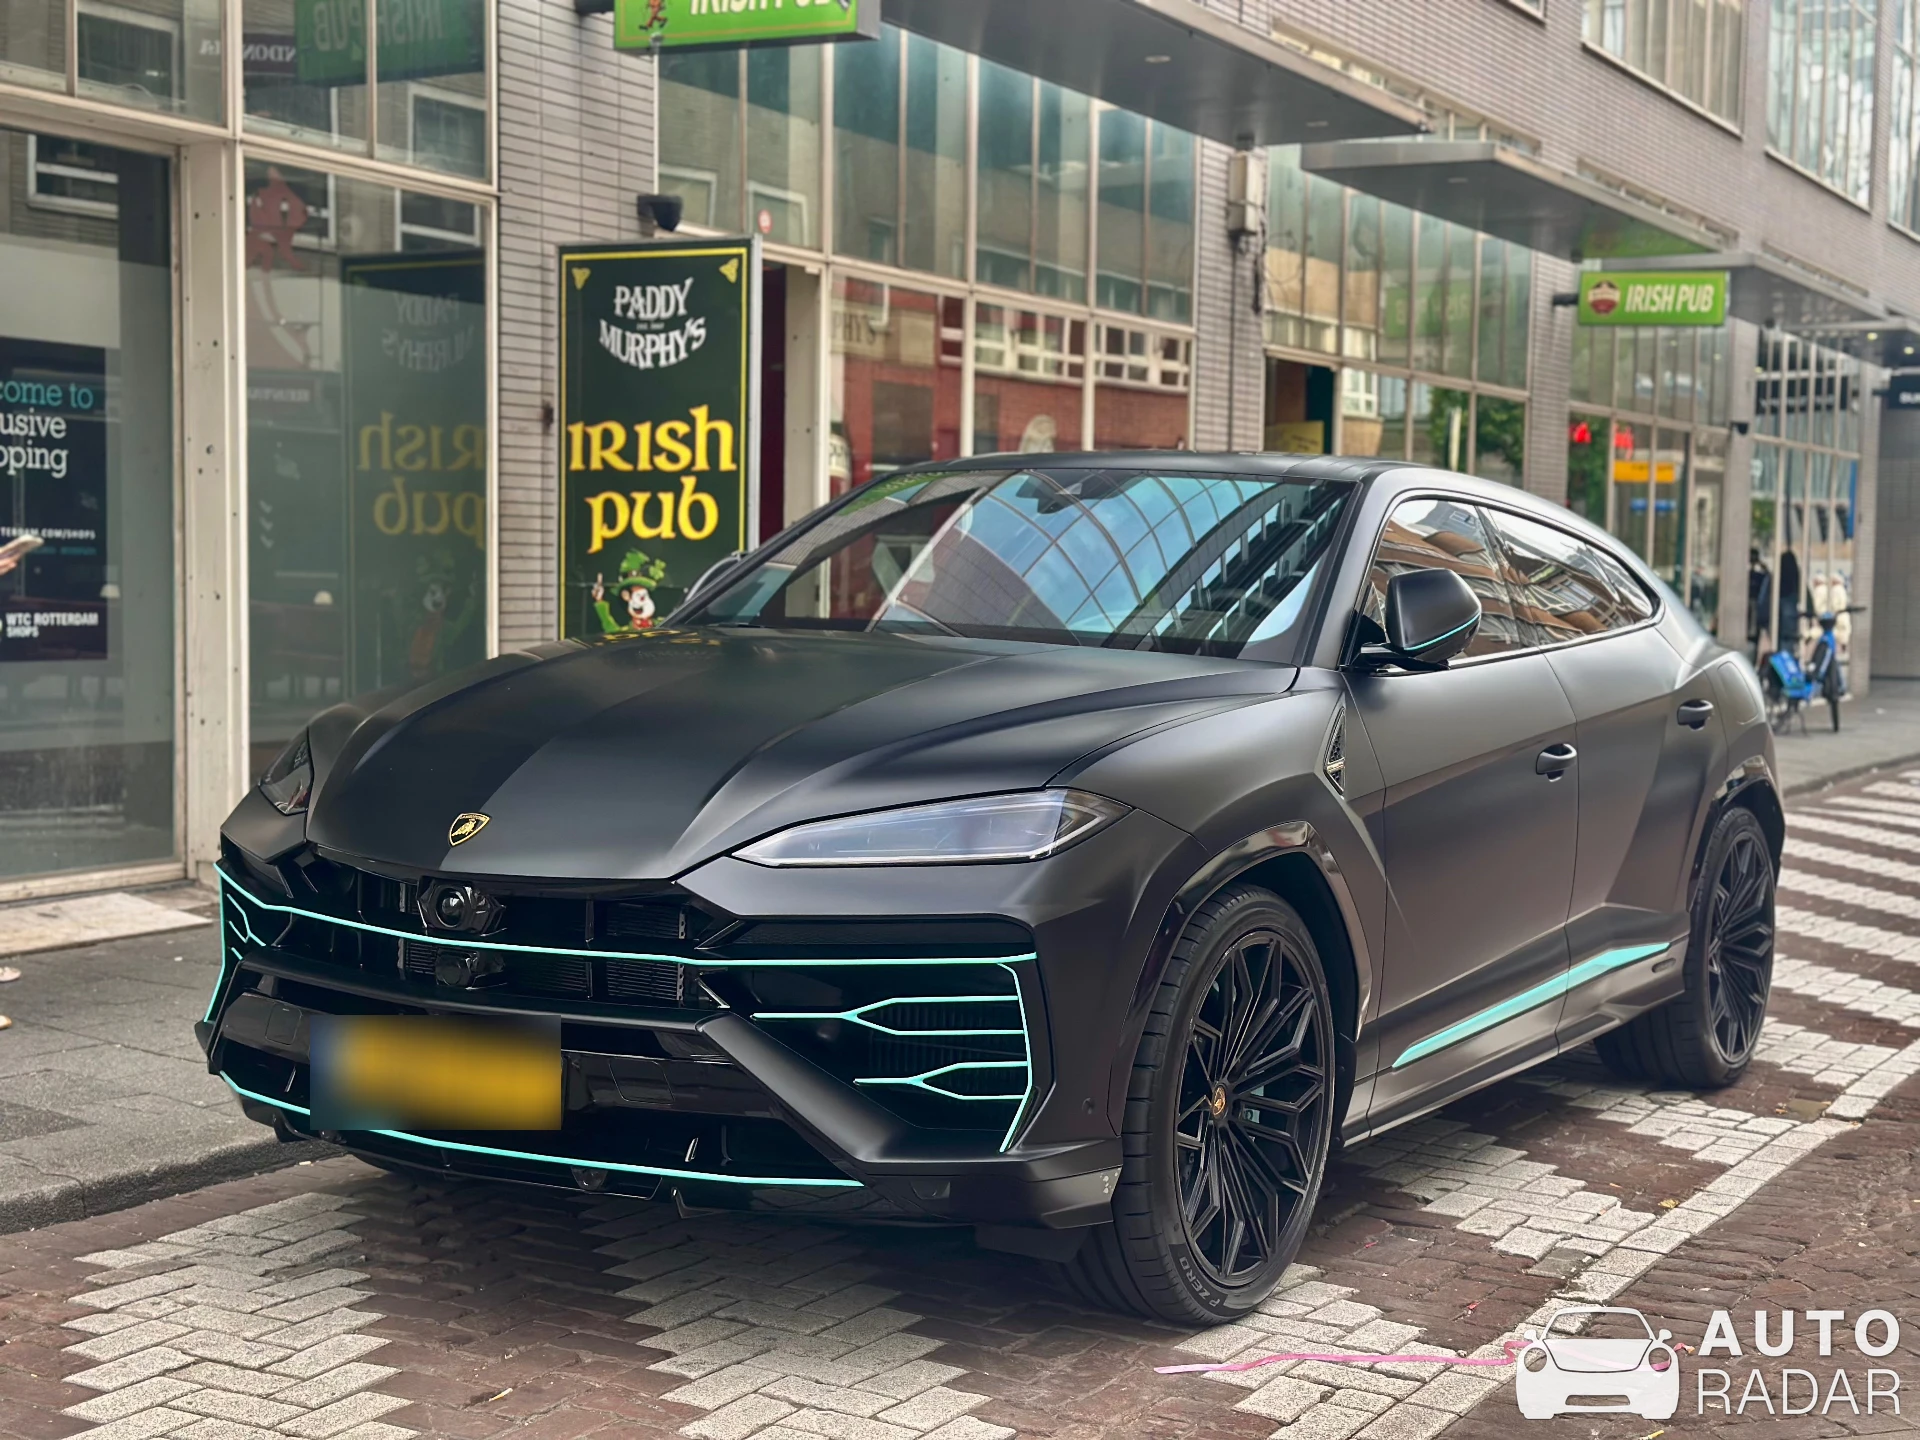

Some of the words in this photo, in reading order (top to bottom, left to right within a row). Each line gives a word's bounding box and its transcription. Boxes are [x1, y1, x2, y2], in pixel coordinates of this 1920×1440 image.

[614, 276, 694, 322] PADDY
[1624, 284, 1676, 313] IRISH
[1676, 284, 1715, 313] PUB
[599, 316, 707, 371] MURPHY'S
[70, 382, 94, 410] to
[0, 407, 67, 439] usive
[584, 475, 719, 554] pub
[5, 612, 32, 626] WTC
[33, 612, 99, 627] ROTTERDAM
[6, 626, 40, 638] SHOPS
[1179, 1256, 1211, 1300] ZERO
